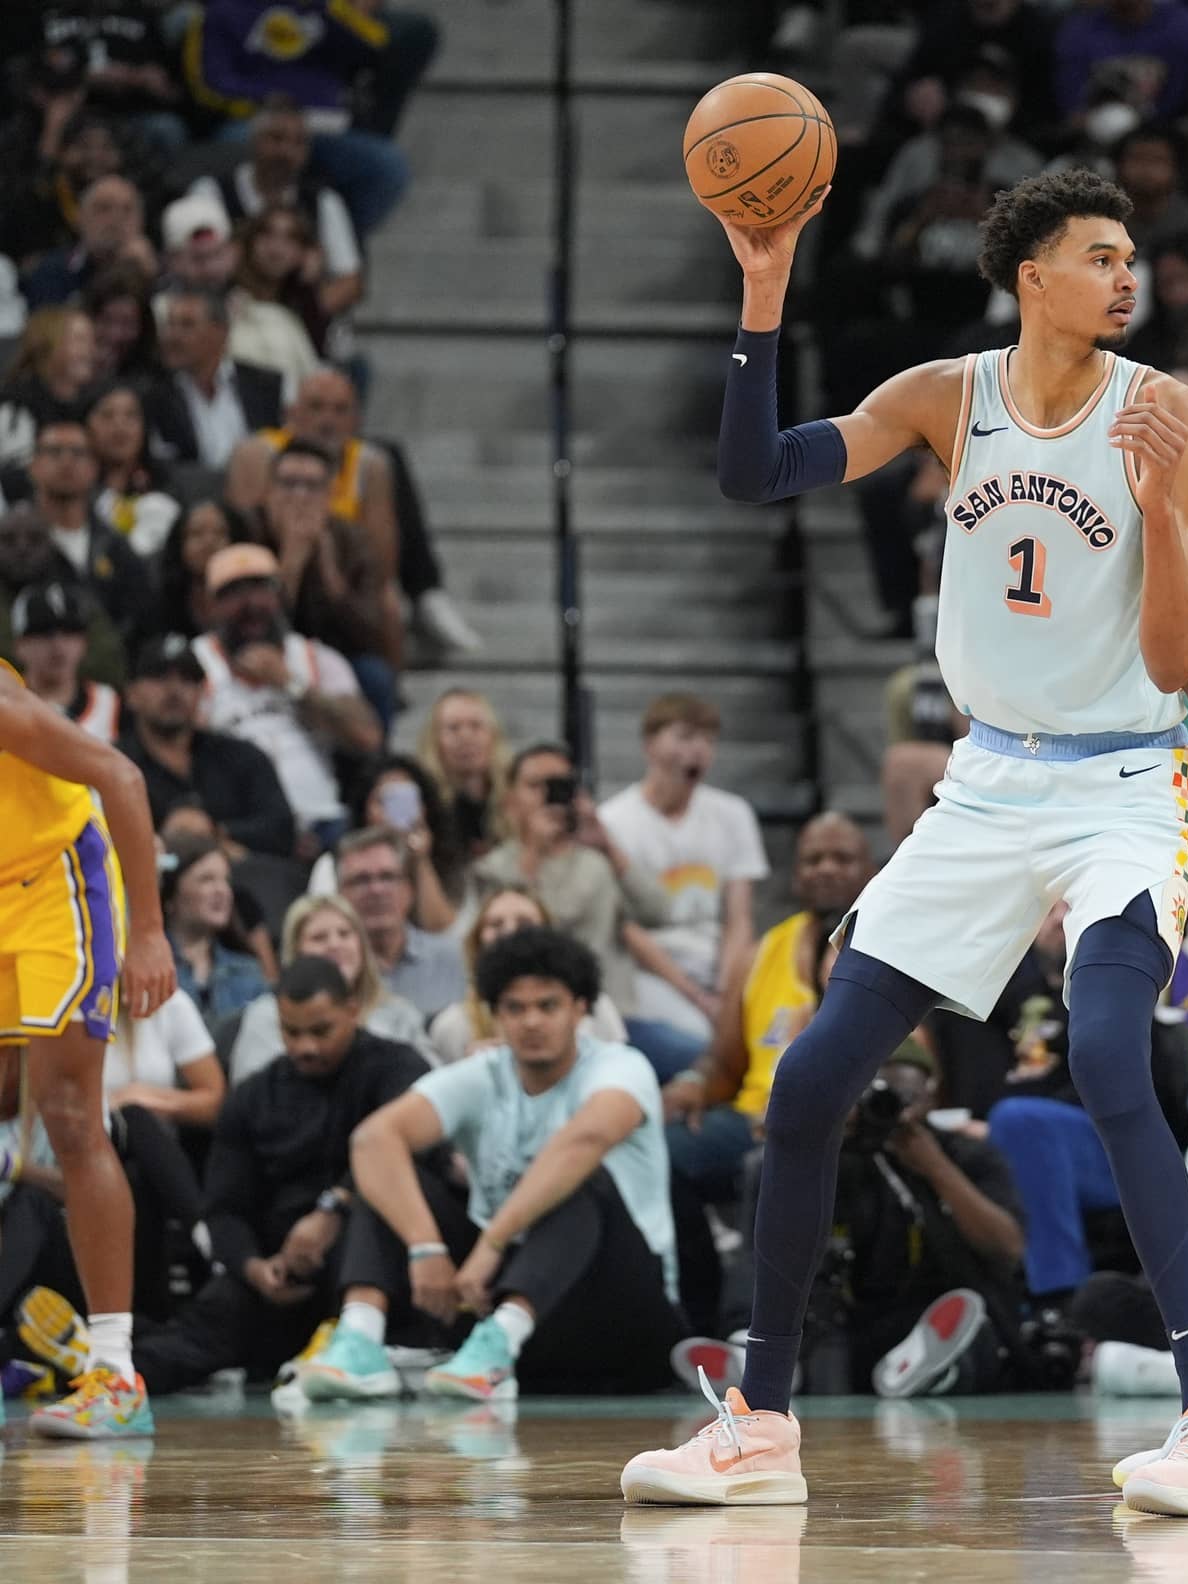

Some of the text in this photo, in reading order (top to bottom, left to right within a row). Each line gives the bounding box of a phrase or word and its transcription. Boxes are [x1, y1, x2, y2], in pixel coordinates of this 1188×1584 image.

[952, 472, 1116, 549] SAN ANTONIO
[1006, 537, 1046, 610] 1
